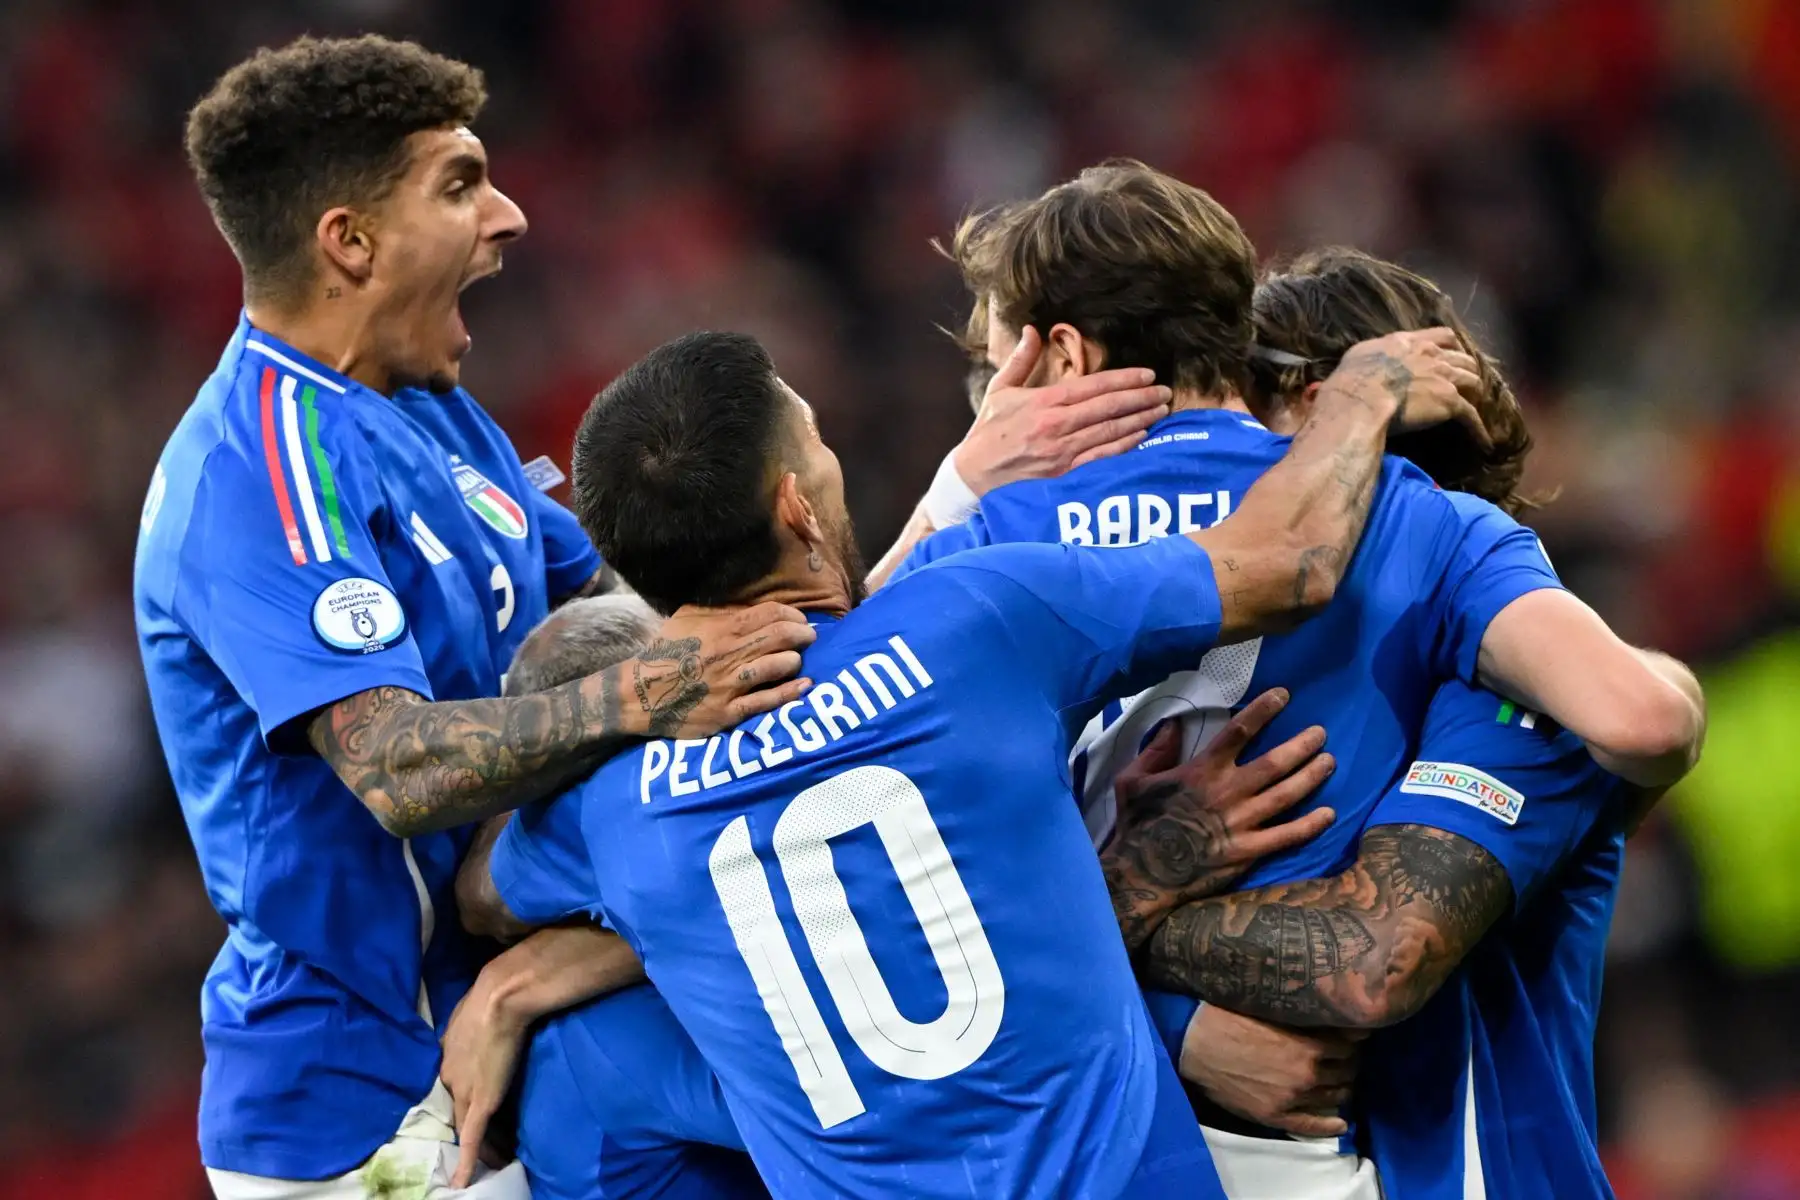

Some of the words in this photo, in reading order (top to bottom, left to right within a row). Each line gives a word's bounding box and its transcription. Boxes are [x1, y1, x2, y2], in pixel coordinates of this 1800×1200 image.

[328, 591, 380, 606] EUROPEAN
[331, 598, 383, 613] CHAMPIONS
[363, 644, 385, 654] 2020
[640, 634, 934, 804] PELLEGRINI
[708, 764, 1005, 1131] 10
